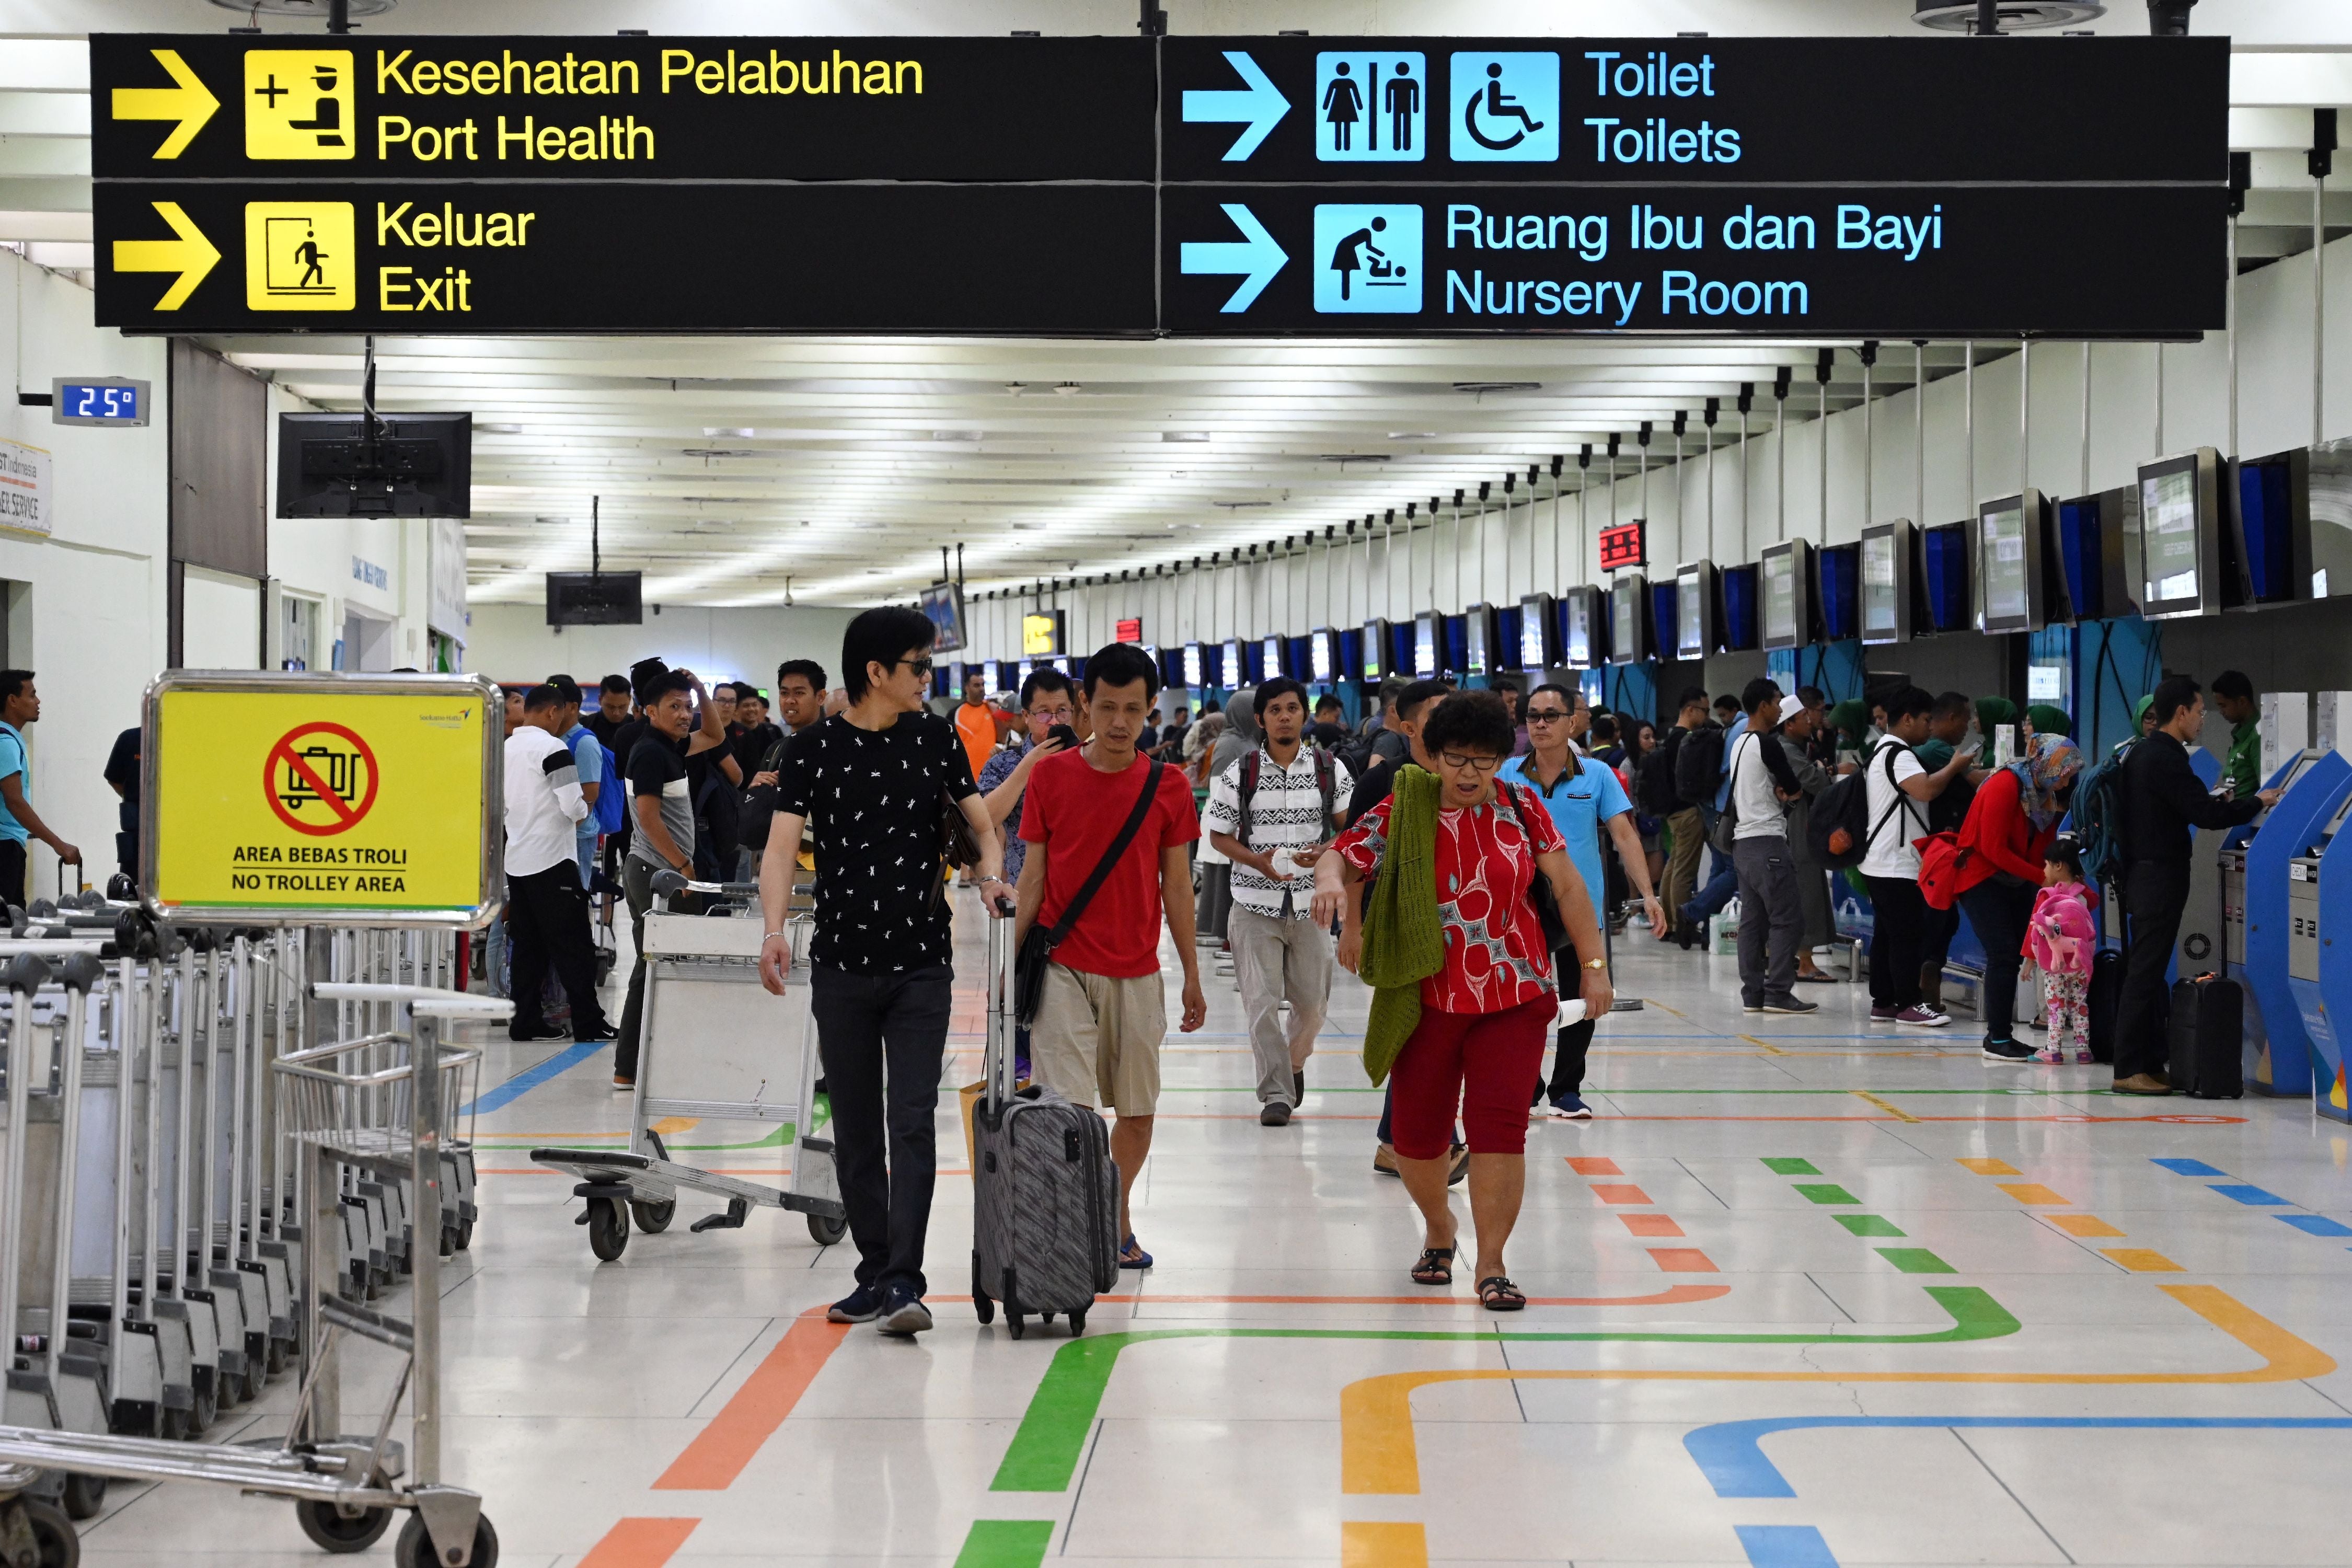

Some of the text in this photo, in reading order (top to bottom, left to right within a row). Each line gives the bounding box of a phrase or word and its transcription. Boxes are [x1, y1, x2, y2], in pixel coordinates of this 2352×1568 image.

[376, 49, 923, 95] Kesehatan Pelabuhan
[1584, 51, 1716, 98] Toilet
[377, 115, 655, 162] Port Health
[1583, 118, 1742, 164] Toilets
[377, 202, 535, 248] Keluar
[1446, 204, 1942, 261] Ruang Ibu dan Bayi
[379, 266, 472, 312] Exit
[1446, 269, 1808, 327] Nursery Room
[8, 456, 37, 478] Indonesia
[12, 493, 38, 521] SERVICE
[233, 846, 407, 864] AREA BEBAS TROLI
[232, 874, 406, 893] NO TROLLEY AREA
